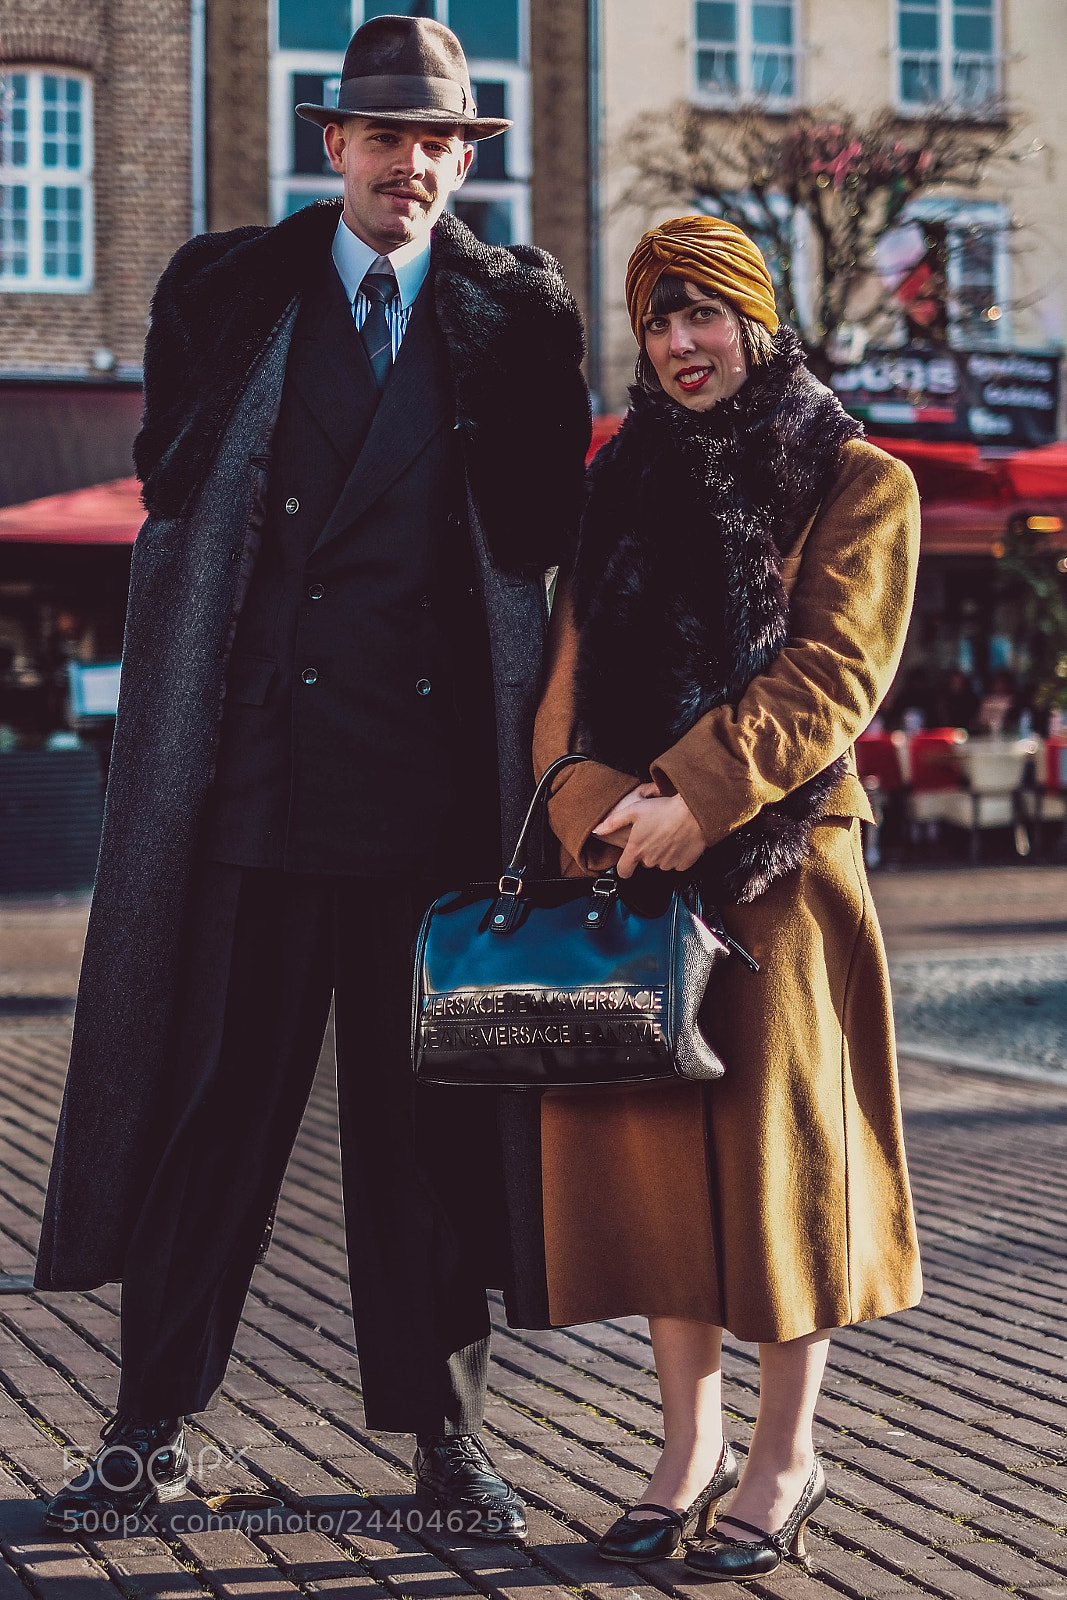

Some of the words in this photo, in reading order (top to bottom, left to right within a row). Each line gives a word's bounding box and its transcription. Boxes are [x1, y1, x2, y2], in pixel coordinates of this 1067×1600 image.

[568, 990, 664, 1011] VERSACE
[422, 1026, 480, 1049] JEANS
[480, 1024, 571, 1046] VERSACE
